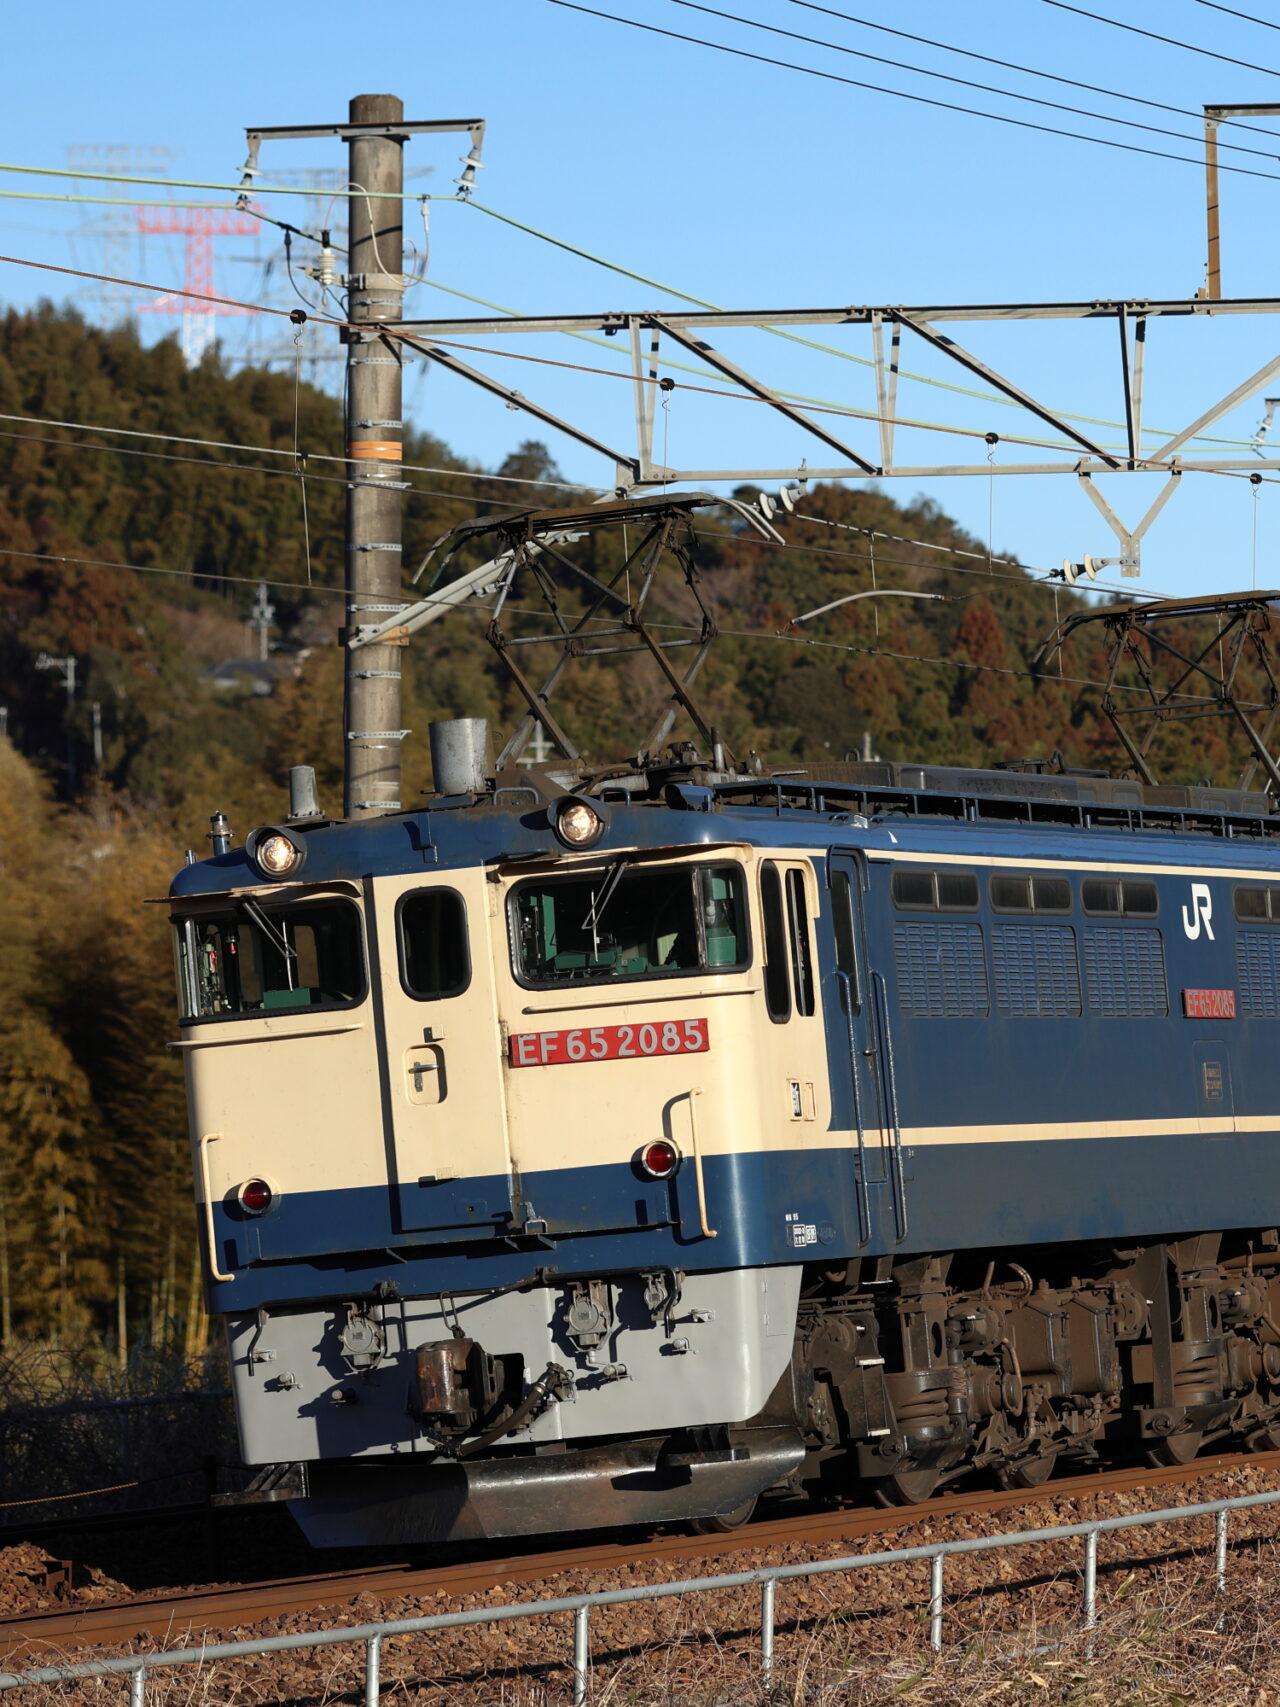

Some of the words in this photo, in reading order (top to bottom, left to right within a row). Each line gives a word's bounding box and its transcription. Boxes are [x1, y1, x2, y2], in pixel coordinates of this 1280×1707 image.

[1182, 883, 1215, 940] JR
[1186, 991, 1200, 1015] EF
[517, 1033, 558, 1065] EF
[566, 1029, 608, 1060] 65
[616, 1020, 703, 1057] 2085
